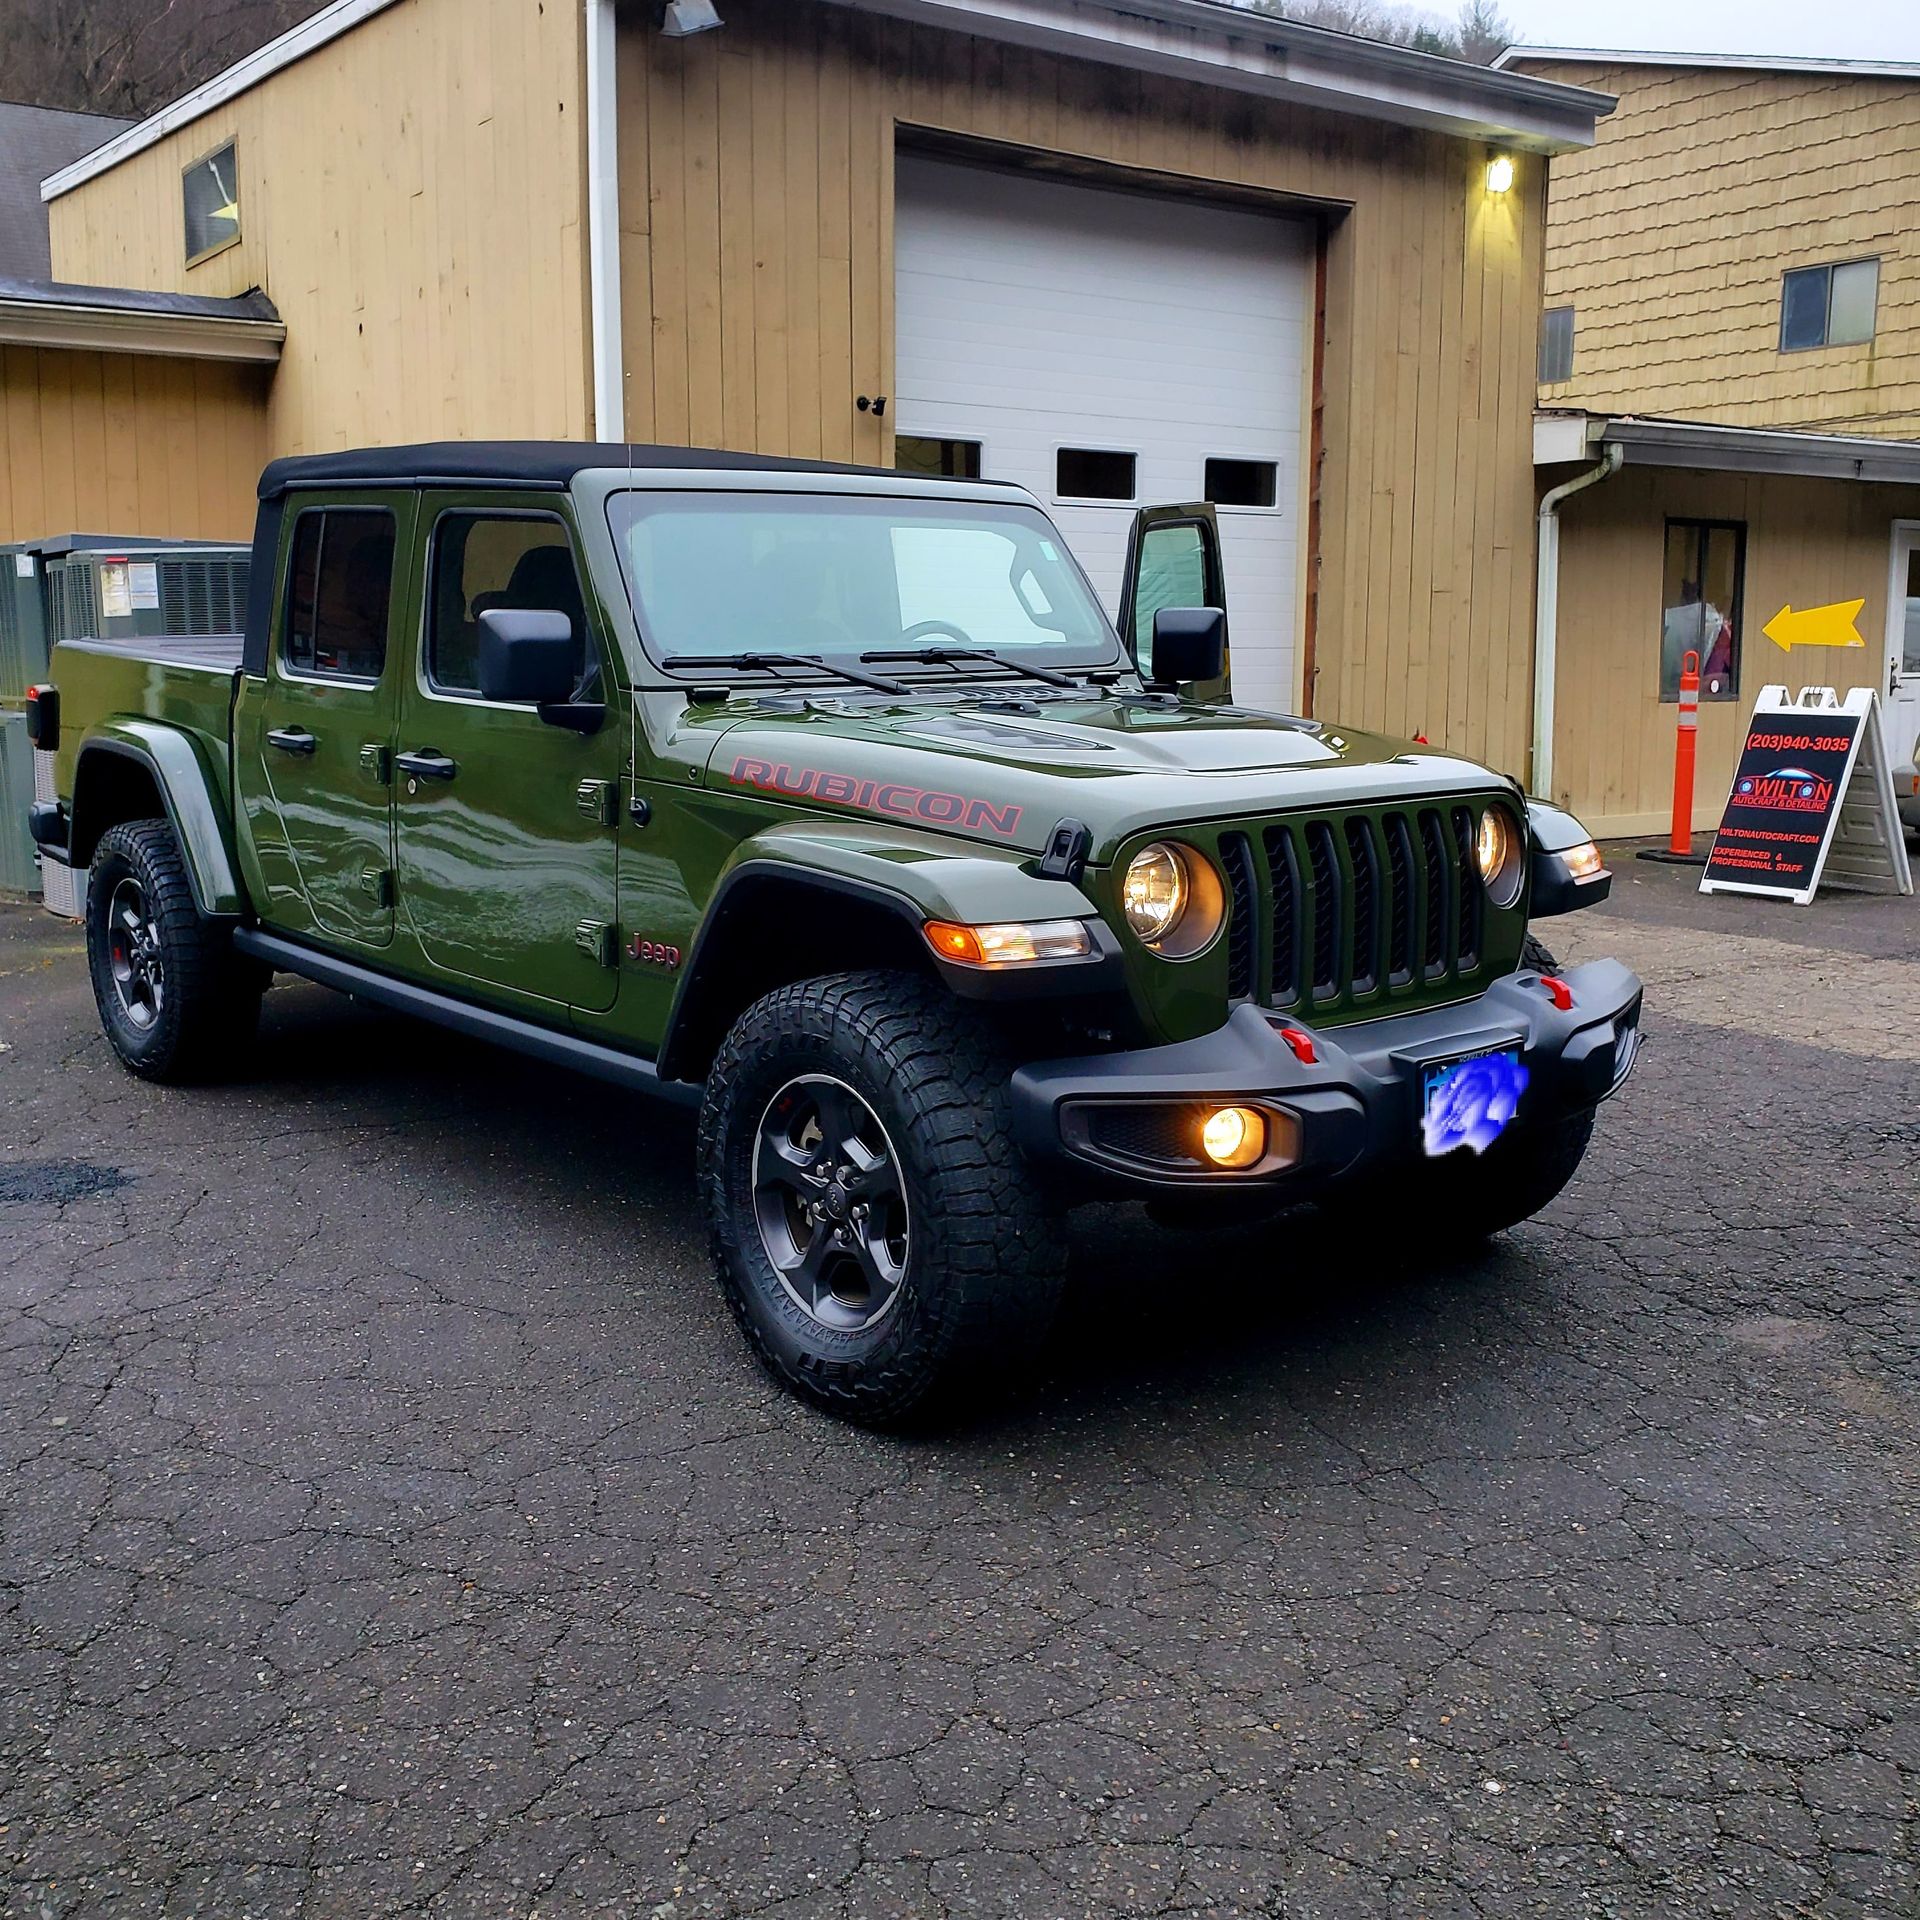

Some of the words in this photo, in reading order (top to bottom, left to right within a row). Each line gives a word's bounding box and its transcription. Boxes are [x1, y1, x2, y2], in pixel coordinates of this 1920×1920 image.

[1747, 733, 1850, 752] (203)940-3035
[730, 757, 1022, 836] RUBICON
[1754, 778, 1833, 801] WILTON
[1732, 796, 1779, 806] AUTOCRAFT
[1778, 800, 1785, 808] &
[1785, 801, 1827, 811] DETAILING
[1719, 828, 1820, 844] WILTONAUTOCRAFT.COM
[1713, 847, 1771, 860] EXPERIENCED
[1775, 853, 1783, 861] &
[1711, 857, 1773, 870] PROFESSIONAL
[1775, 863, 1803, 873] STAFF
[626, 932, 681, 972] Jeep
